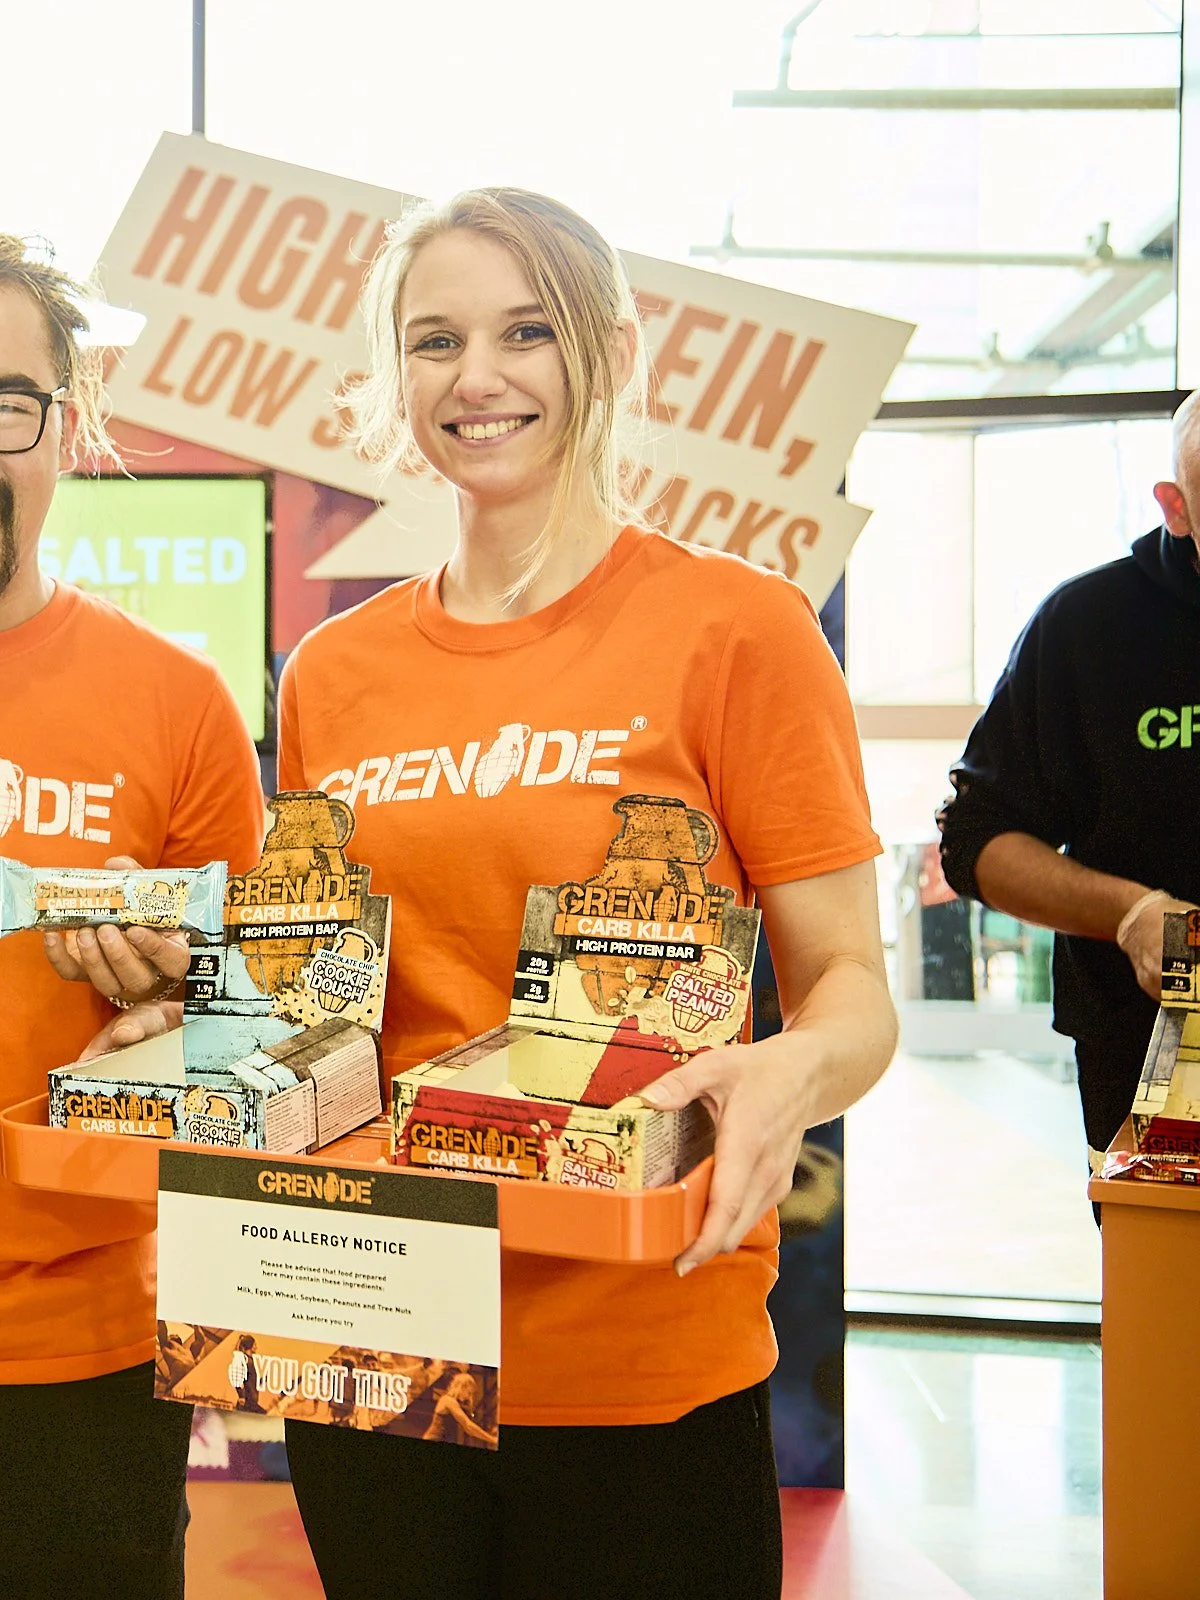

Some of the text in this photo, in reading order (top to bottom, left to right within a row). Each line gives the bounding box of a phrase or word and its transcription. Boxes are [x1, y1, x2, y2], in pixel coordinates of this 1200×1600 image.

[131, 164, 388, 334] HIGH
[140, 313, 321, 428] LOW
[38, 536, 248, 586] SALTED
[47, 898, 111, 909] CARB KILLA
[138, 897, 176, 911] COOKIE
[239, 903, 339, 923] CARB KILLA
[557, 884, 726, 925] GRENADE
[239, 922, 339, 939] HIGH PROTEIN BAR
[577, 918, 696, 943] CARB KILLA
[320, 951, 375, 970] CHOCOLATE CHIP
[576, 939, 695, 959] HIGH PROTEIN BAR
[198, 960, 214, 971] 20g
[530, 956, 548, 969] 20g
[312, 960, 372, 991] COOKIE
[680, 963, 742, 989] WHITE CHOCOLATE
[196, 984, 214, 995] 1.9g
[310, 975, 366, 1003] DOUGH
[529, 983, 543, 995] 2g
[672, 974, 735, 1006] SALTED
[666, 987, 730, 1020] PEANUT
[64, 1093, 174, 1122] GRENADE
[193, 1113, 225, 1125] CHOCOLATE
[80, 1119, 158, 1136] CARB KILLA
[189, 1121, 241, 1145] COOKIE
[410, 1123, 538, 1160] GRENADE
[426, 1150, 469, 1168] CARB
[473, 1154, 519, 1174] KILLA
[563, 1159, 618, 1188] SALTED
[257, 1170, 373, 1205] GRENADE
[241, 1224, 408, 1256] FOOD ALLERGY NOTICE
[260, 1260, 283, 1269] Please
[295, 1264, 321, 1274] advised
[322, 1267, 336, 1275] that
[338, 1269, 353, 1278] food
[354, 1272, 387, 1284] prepared
[262, 1270, 278, 1278] here
[279, 1273, 294, 1281] may
[295, 1274, 320, 1283] contain
[322, 1277, 341, 1286] these
[237, 1286, 412, 1315] Milk, Eggs, Wheat, Soybean, Peanuts and Tree Nuts
[291, 1312, 304, 1320] Ask
[306, 1314, 328, 1324] before
[343, 1320, 354, 1328] try
[253, 1353, 412, 1415] YOU GOT THIS
